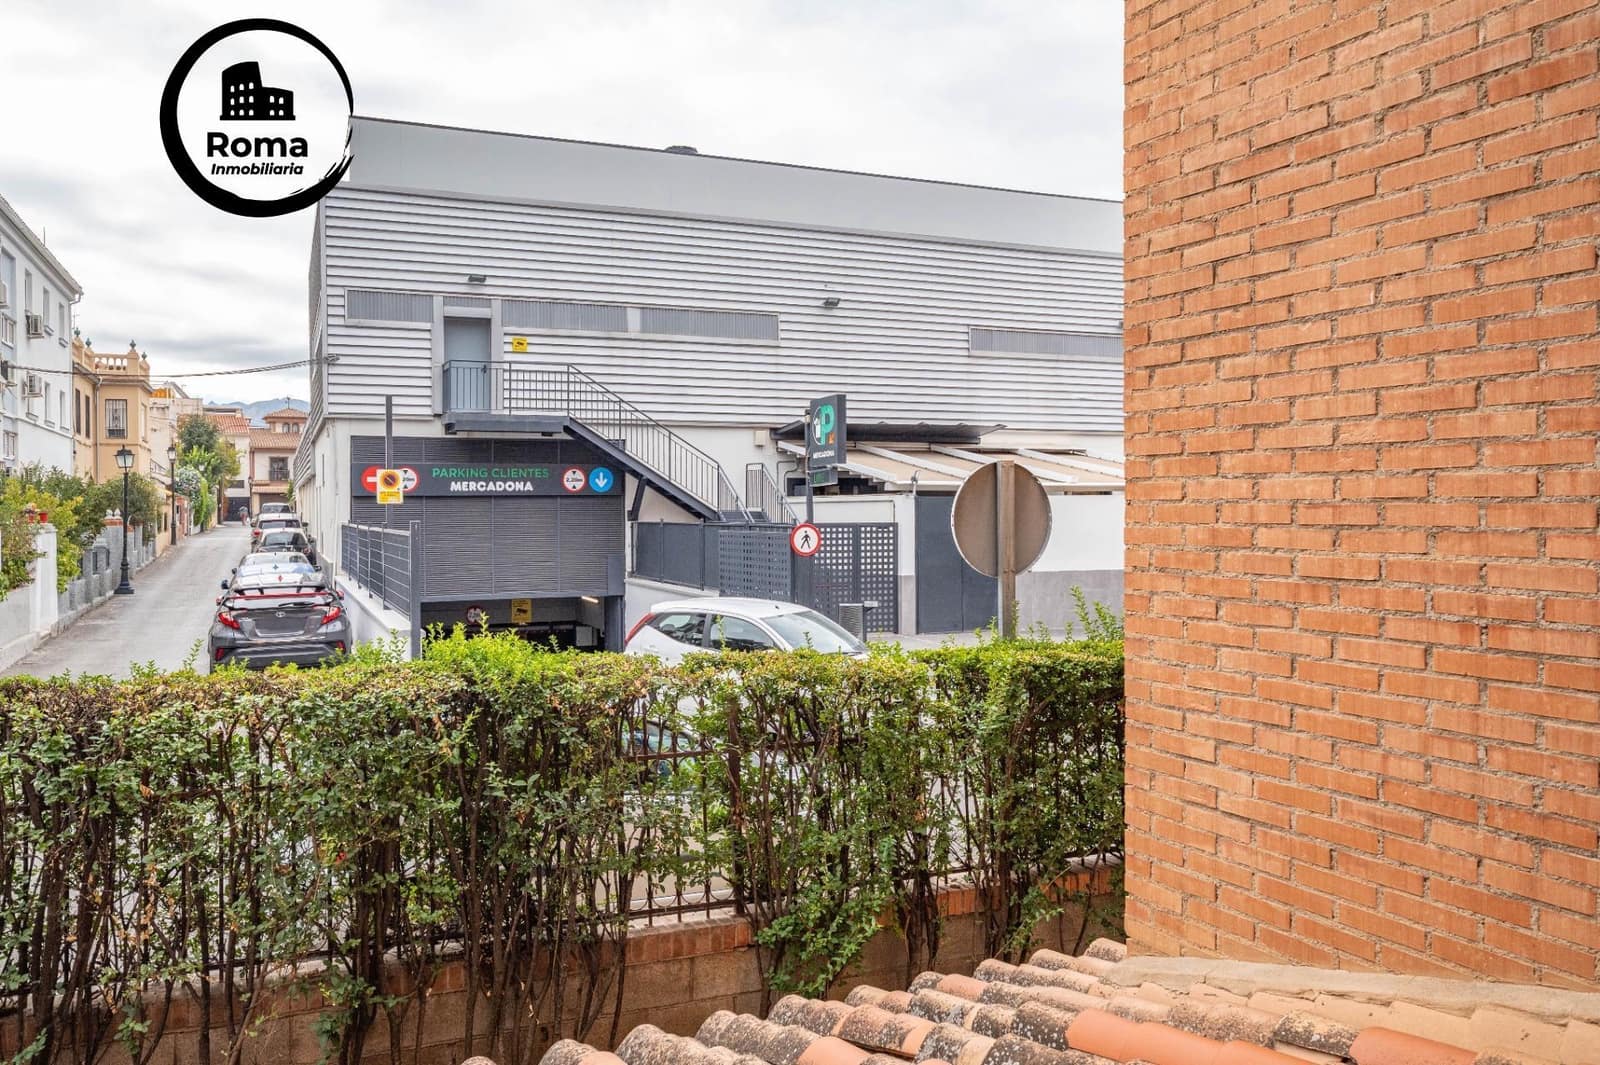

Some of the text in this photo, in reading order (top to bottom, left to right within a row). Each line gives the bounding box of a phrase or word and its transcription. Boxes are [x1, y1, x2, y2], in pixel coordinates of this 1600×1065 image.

[432, 467, 550, 479] PARKING CLIENTES
[450, 481, 533, 491] MERCADONA
